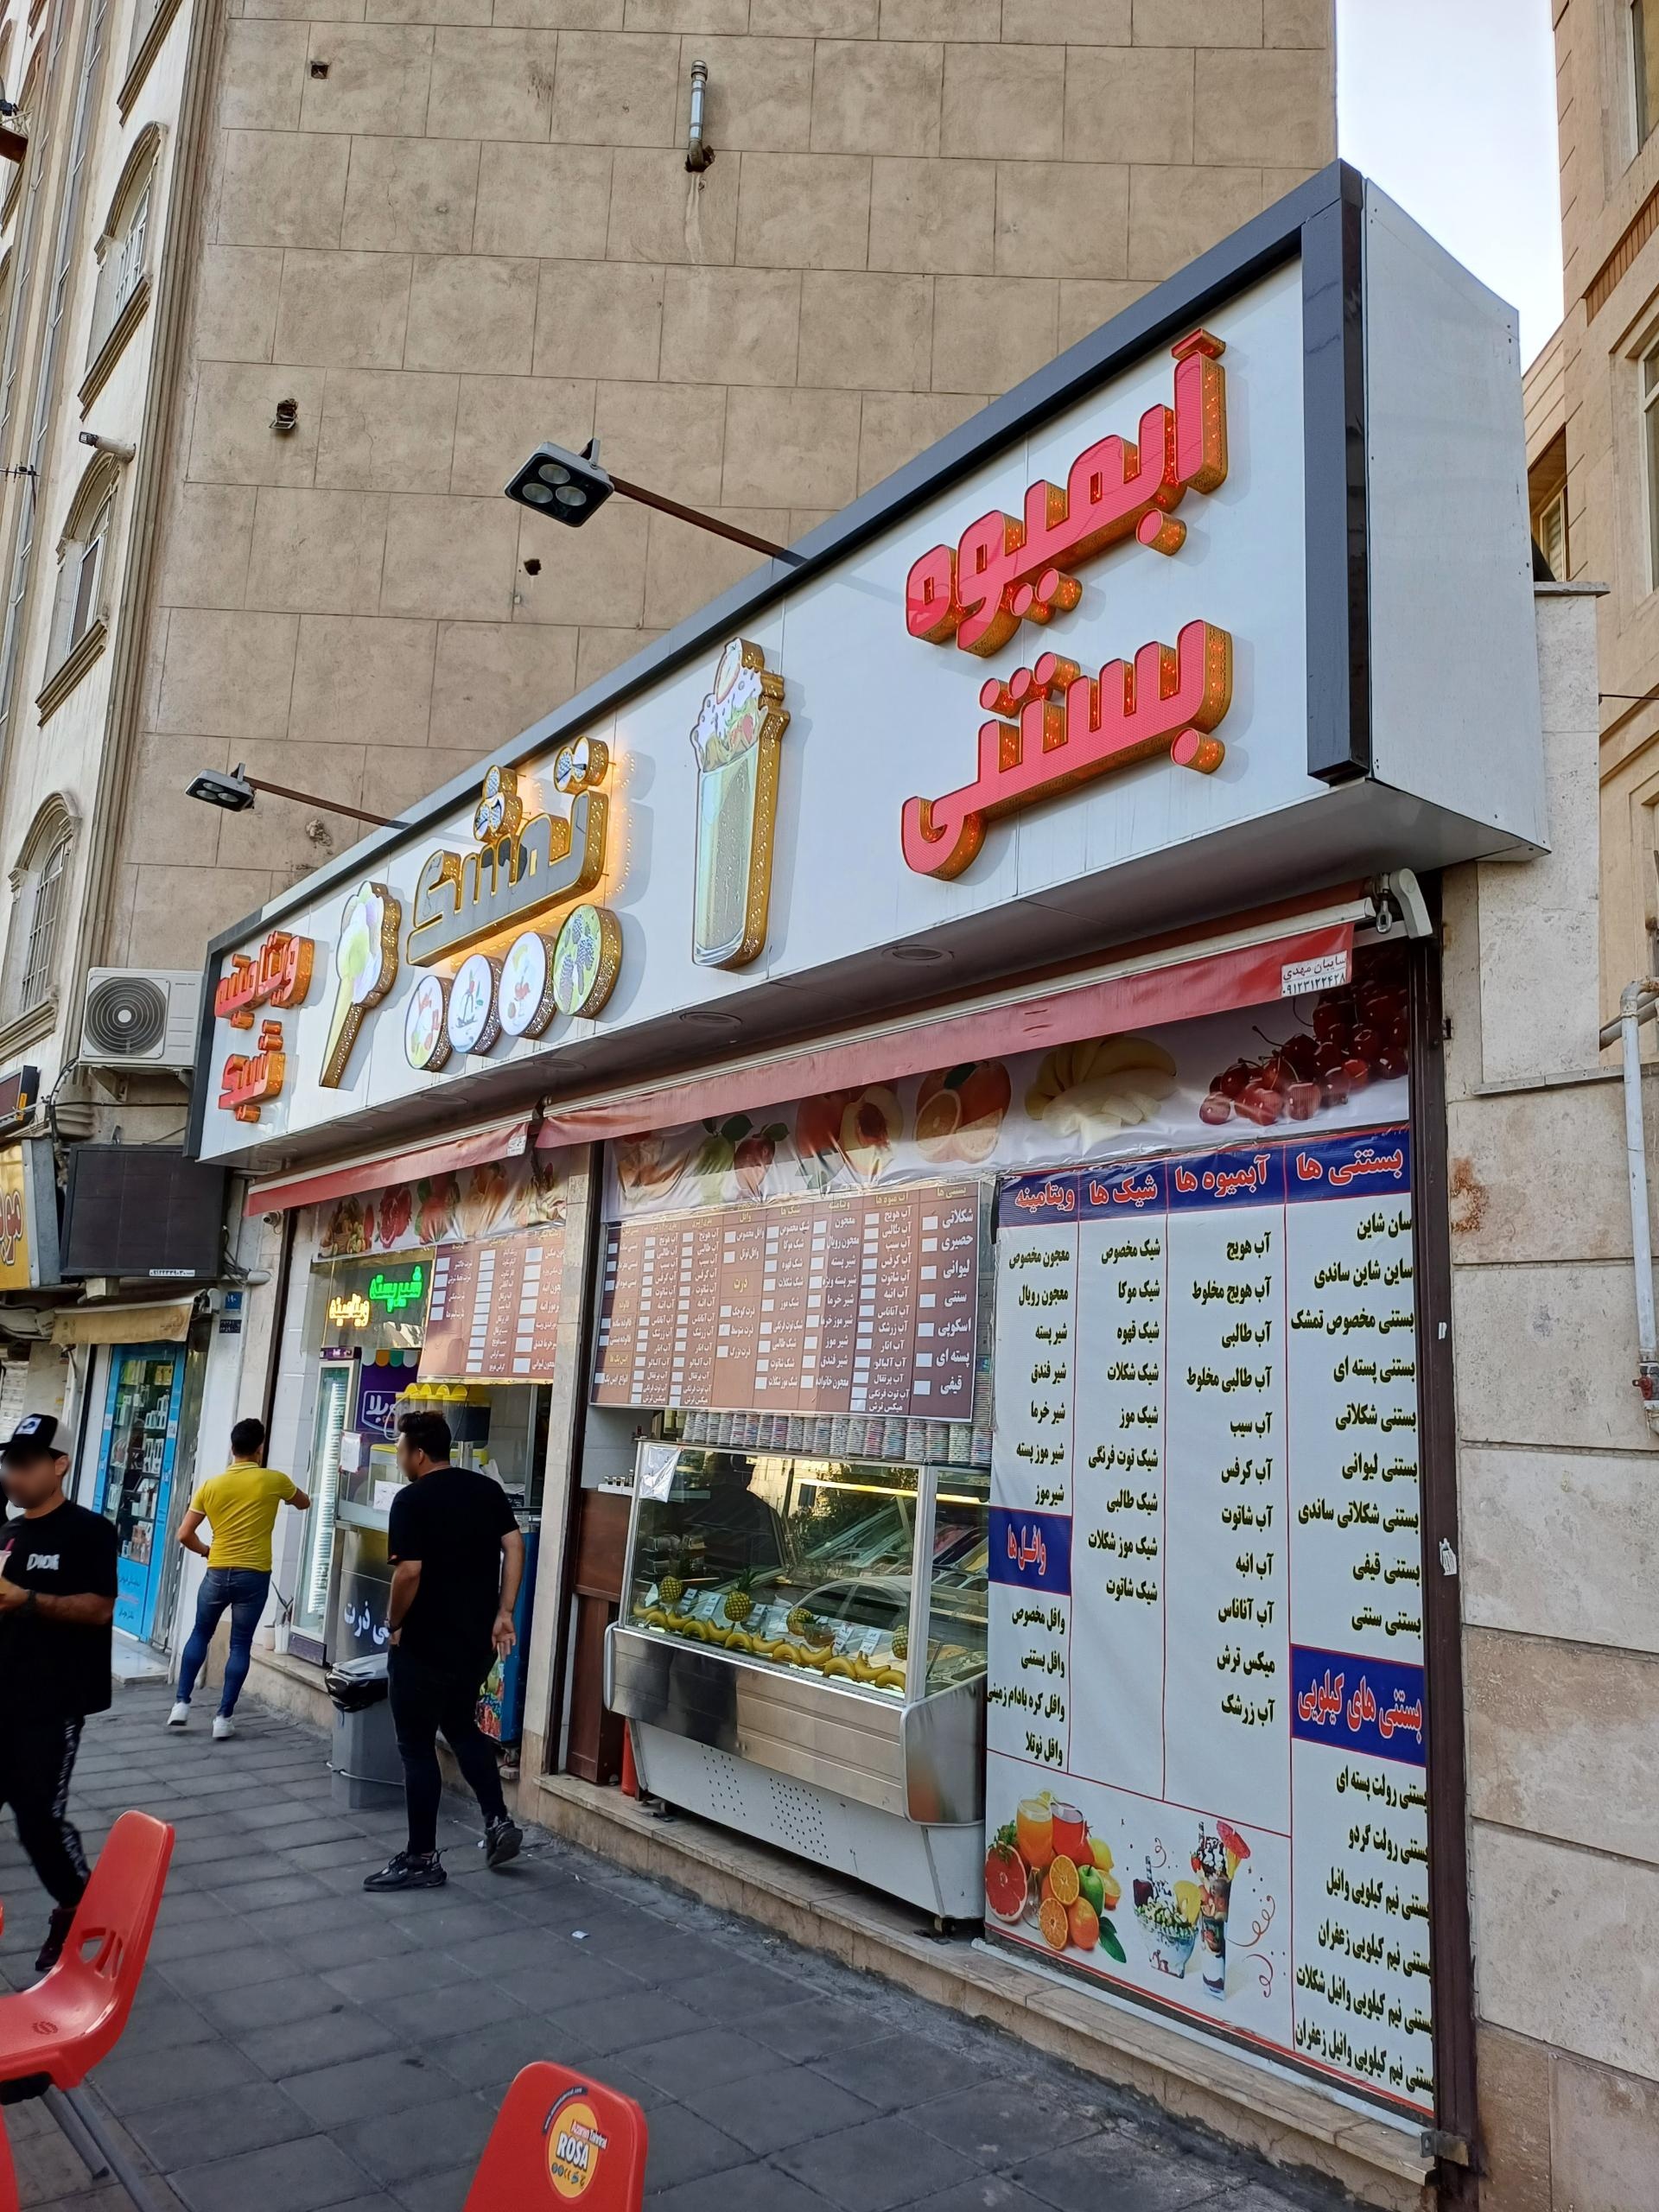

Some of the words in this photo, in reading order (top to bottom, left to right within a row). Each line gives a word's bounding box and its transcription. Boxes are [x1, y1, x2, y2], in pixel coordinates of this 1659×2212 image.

[902, 620, 1232, 880] بستنی
[1283, 966, 1311, 981] مهدی
[1314, 957, 1346, 974] سایبان
[1175, 1166, 1196, 1192] ها
[1202, 1154, 1270, 1197] آبمیوه
[1296, 1154, 1322, 1180] ها
[1328, 1149, 1404, 1185] بستنی
[1015, 1182, 1075, 1211] ویتامینه
[1089, 1181, 1108, 1205] ها
[1113, 1175, 1158, 1208] شیک
[943, 1208, 973, 1229] شکلاتی
[1357, 1212, 1384, 1240] شاین
[1389, 1210, 1412, 1237] سان
[942, 1235, 973, 1251] حصیری
[1102, 1240, 1137, 1264] مخصوص
[1140, 1238, 1160, 1260] شیک
[1227, 1240, 1251, 1261] هویج
[1255, 1231, 1271, 1259] آب
[943, 1258, 969, 1278] لیوانی
[1009, 1247, 1041, 1268] مخصوص
[1043, 1249, 1070, 1268] معجون
[1314, 1262, 1350, 1288] ساندی
[1353, 1260, 1380, 1287] شاین
[1384, 1258, 1414, 1286] ساین
[944, 1291, 967, 1307] سنتی
[1019, 1284, 1039, 1306] رویال
[1042, 1287, 1068, 1306] معجون
[1118, 1281, 1136, 1304] موکا
[1139, 1280, 1160, 1301] شیک
[1192, 1280, 1224, 1305] مخلوط
[1226, 1283, 1252, 1304] هویج
[1255, 1276, 1271, 1303] آب
[1291, 1309, 1323, 1329] تمشک
[1327, 1308, 1375, 1335] مخصوص
[1379, 1310, 1414, 1334] بستنی
[1036, 1325, 1052, 1345] پسته
[1053, 1323, 1067, 1344] شیر
[1117, 1320, 1135, 1344] قهوه
[1139, 1321, 1159, 1343] شیک
[1222, 1323, 1252, 1348] طالبی
[1255, 1320, 1272, 1348] آب
[937, 1348, 949, 1366] ای
[950, 1350, 969, 1368] پسته
[1334, 1355, 1348, 1382] ای
[1032, 1360, 1051, 1383] فندق
[1052, 1362, 1066, 1384] شیر
[1108, 1362, 1135, 1381] شکلات
[1138, 1363, 1159, 1385] شیک
[1186, 1366, 1219, 1392] مخلوط
[1222, 1367, 1252, 1392] طالبی
[1255, 1366, 1272, 1393] آب
[1352, 1359, 1376, 1383] پسته
[1380, 1359, 1414, 1382] بستنی
[940, 1376, 962, 1395] قیفی
[1031, 1400, 1049, 1423] خرما
[1052, 1402, 1065, 1424] شیر
[1119, 1408, 1135, 1428] موز
[1137, 1406, 1158, 1428] شیک
[1336, 1402, 1377, 1430] شکلاتی
[1381, 1408, 1416, 1432] بستنی
[1230, 1421, 1252, 1437] سیب
[1255, 1412, 1273, 1438] آب
[1017, 1442, 1033, 1464] پسته
[1035, 1444, 1048, 1464] موز
[1051, 1443, 1065, 1465] شیر
[1089, 1445, 1115, 1470] فرنگی
[1117, 1448, 1135, 1471] توت
[1137, 1448, 1158, 1471] شیک
[1222, 1457, 1252, 1484] کرفس
[1255, 1459, 1273, 1485] آب
[1343, 1452, 1377, 1480] لیوانی
[1382, 1458, 1417, 1483] بستنی
[1035, 1484, 1049, 1505] موز
[1049, 1484, 1065, 1506] شیر
[1107, 1490, 1134, 1512] طالبی
[1136, 1492, 1158, 1516] شیک
[1222, 1504, 1253, 1530] شاتوت
[1256, 1505, 1273, 1532] آب
[1299, 1498, 1333, 1524] ساندی
[1338, 1500, 1379, 1529] شکلاتی
[1383, 1509, 1418, 1535] بستنی
[1007, 1523, 1017, 1559] ها
[1018, 1523, 1046, 1575] وافل
[1089, 1529, 1116, 1550] شکلات
[1118, 1537, 1133, 1558] موز
[1136, 1536, 1158, 1560] شیک
[1236, 1553, 1253, 1578] انبه
[1256, 1553, 1274, 1580] آب
[1353, 1553, 1380, 1580] قیفی
[1384, 1560, 1420, 1586] بستنی
[1107, 1577, 1134, 1601] شاتوت
[1136, 1581, 1158, 1605] شیک
[1012, 1605, 1045, 1627] مخصوص
[1046, 1607, 1065, 1635] وافل
[1218, 1598, 1253, 1623] آناناس
[1257, 1601, 1274, 1628] آب
[1351, 1607, 1382, 1630] سنتی
[1385, 1611, 1421, 1639] بستنی
[1021, 1649, 1045, 1672] بستنی
[1047, 1651, 1065, 1678] وافل
[1217, 1645, 1240, 1673] ترش
[1243, 1651, 1275, 1678] میکس
[987, 1683, 1007, 1707] زمینی
[1008, 1686, 1027, 1711] بادام
[1029, 1692, 1043, 1715] کره
[1298, 1669, 1344, 1725] کیلویی
[1347, 1675, 1376, 1732] های
[1045, 1694, 1065, 1722] وافل
[1222, 1694, 1254, 1725] زرشک
[1257, 1699, 1275, 1726] آب
[1379, 1688, 1421, 1745] بستنی
[1337, 1764, 1348, 1793] ای
[1351, 1771, 1370, 1802] پسته
[1372, 1772, 1396, 1807] رولت
[1326, 1866, 1349, 1901] وانیل
[1352, 1878, 1382, 1908] کیلویی
[1386, 1885, 1399, 1915] نیم
[556, 2131, 589, 2171] ROSA
